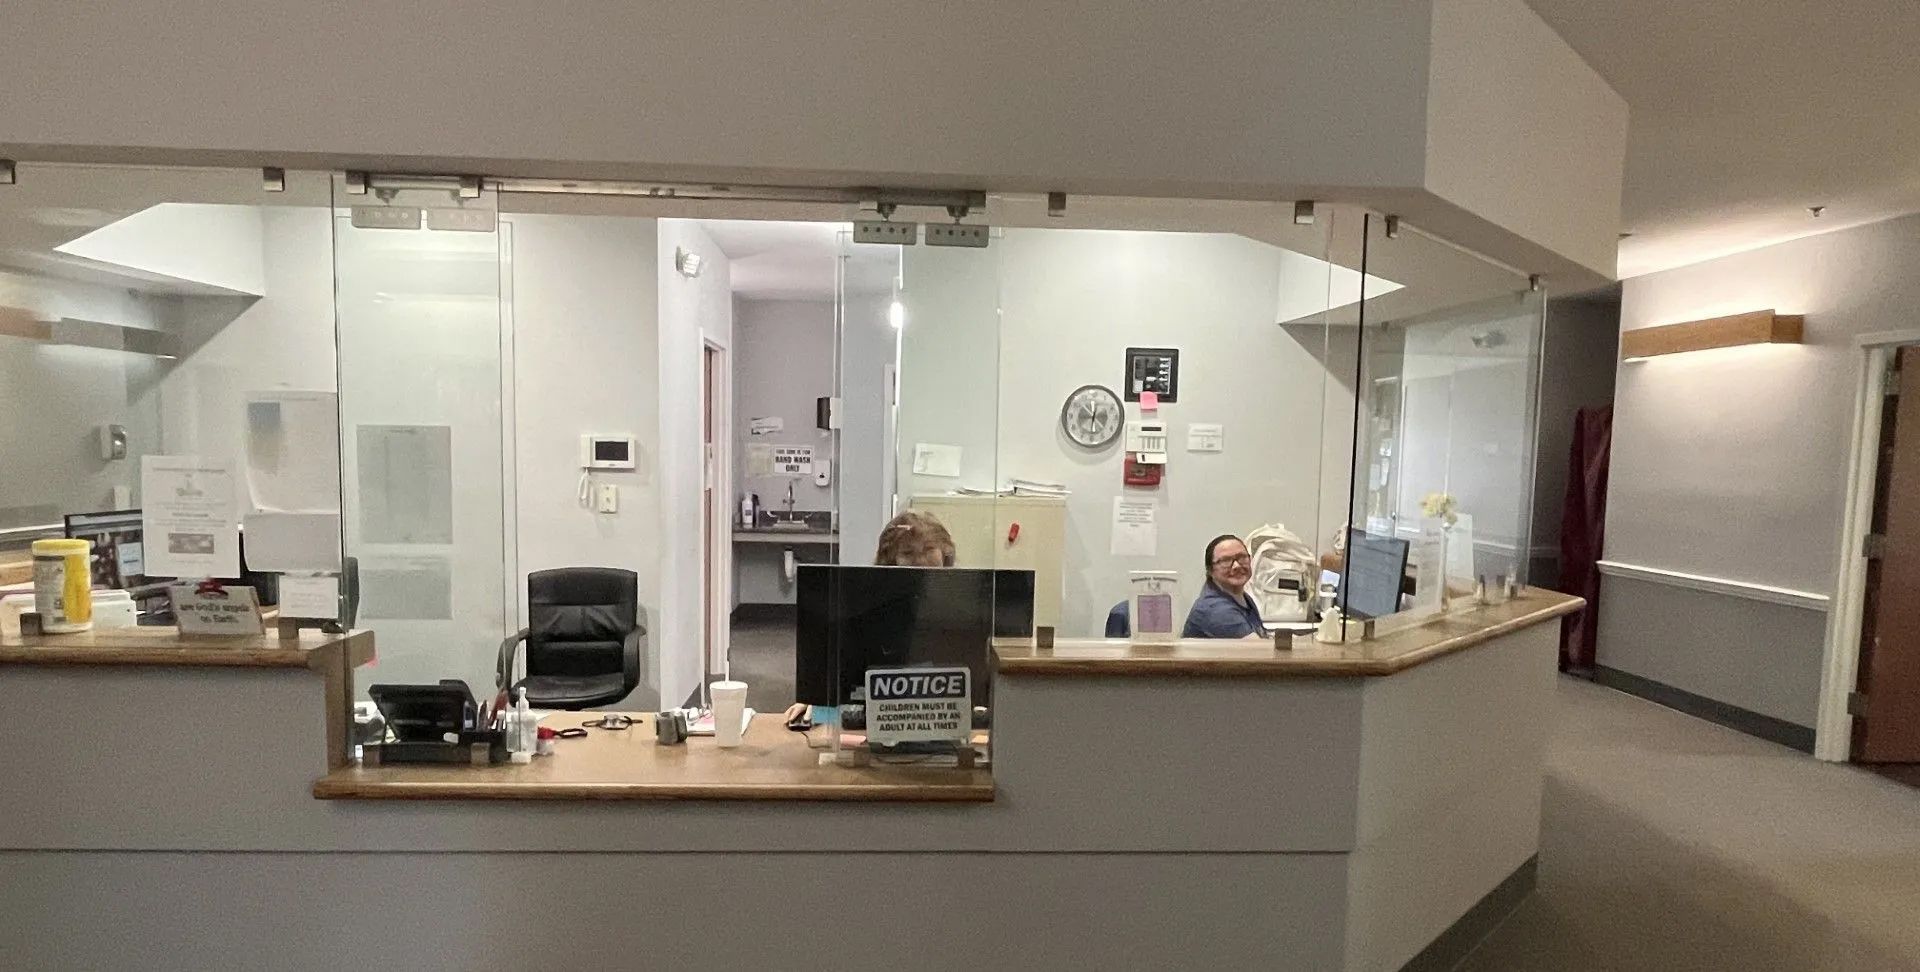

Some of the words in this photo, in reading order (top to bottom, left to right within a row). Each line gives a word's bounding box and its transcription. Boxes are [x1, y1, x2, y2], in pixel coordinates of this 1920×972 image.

[785, 464, 800, 472] ONLY
[874, 676, 962, 696] NOTICE
[879, 703, 920, 712] CHILDREN
[922, 702, 945, 711] MUST
[947, 702, 957, 710] BE
[877, 712, 936, 721] ACCOMPANIED
[937, 712, 948, 720] BY
[879, 723, 906, 731] ADULT
[906, 723, 917, 731] AT
